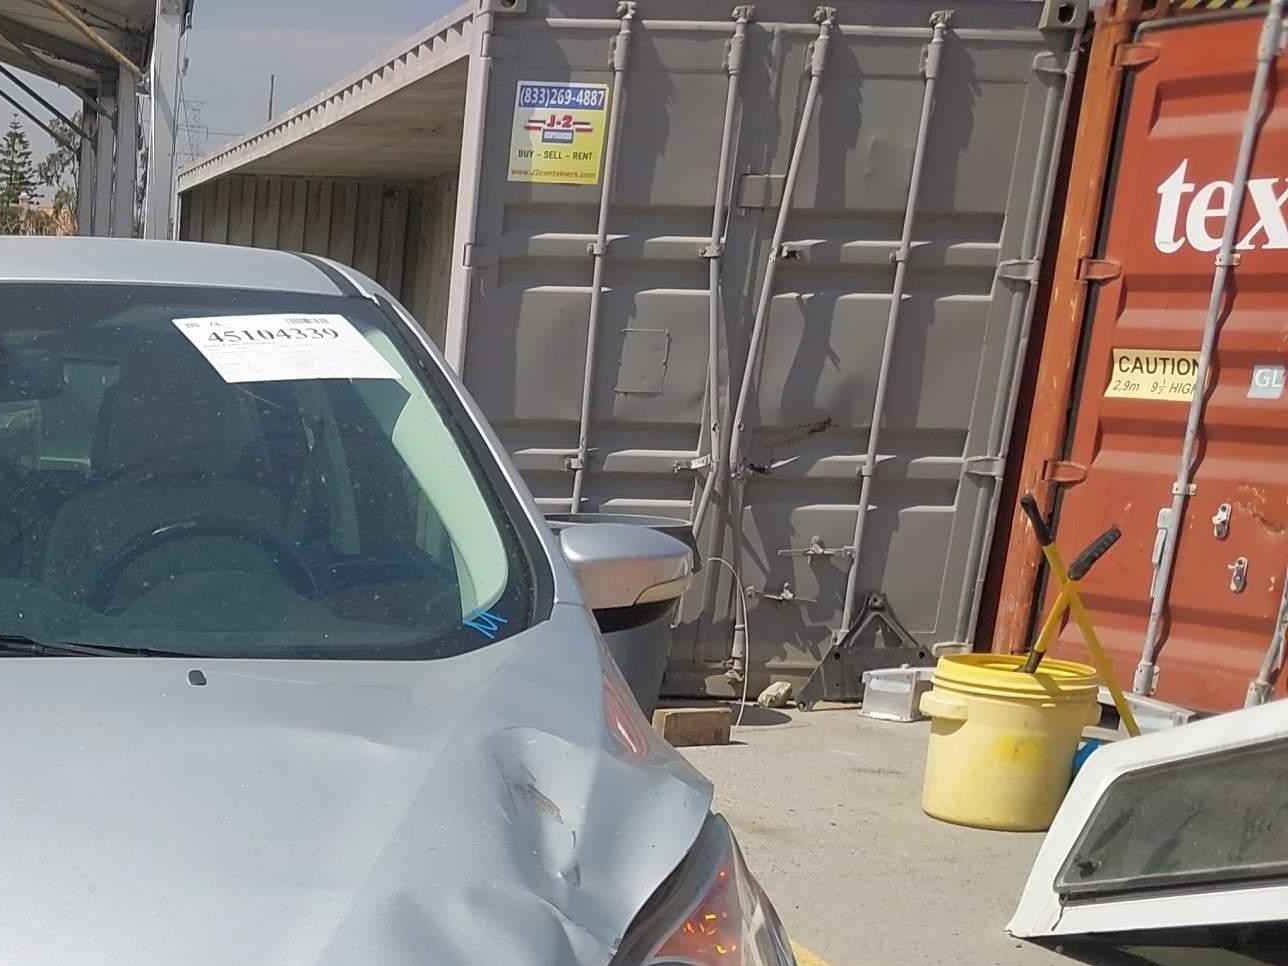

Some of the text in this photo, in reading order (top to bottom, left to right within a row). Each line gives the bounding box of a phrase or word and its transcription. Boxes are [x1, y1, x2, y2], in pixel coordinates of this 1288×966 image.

[520, 87, 605, 107] (833)269-4887
[546, 114, 573, 128] J-2
[518, 150, 534, 158] BUY
[544, 151, 562, 159] SELL
[573, 152, 593, 160] RENT
[1155, 159, 1288, 253] tex
[208, 327, 339, 343] 45104339
